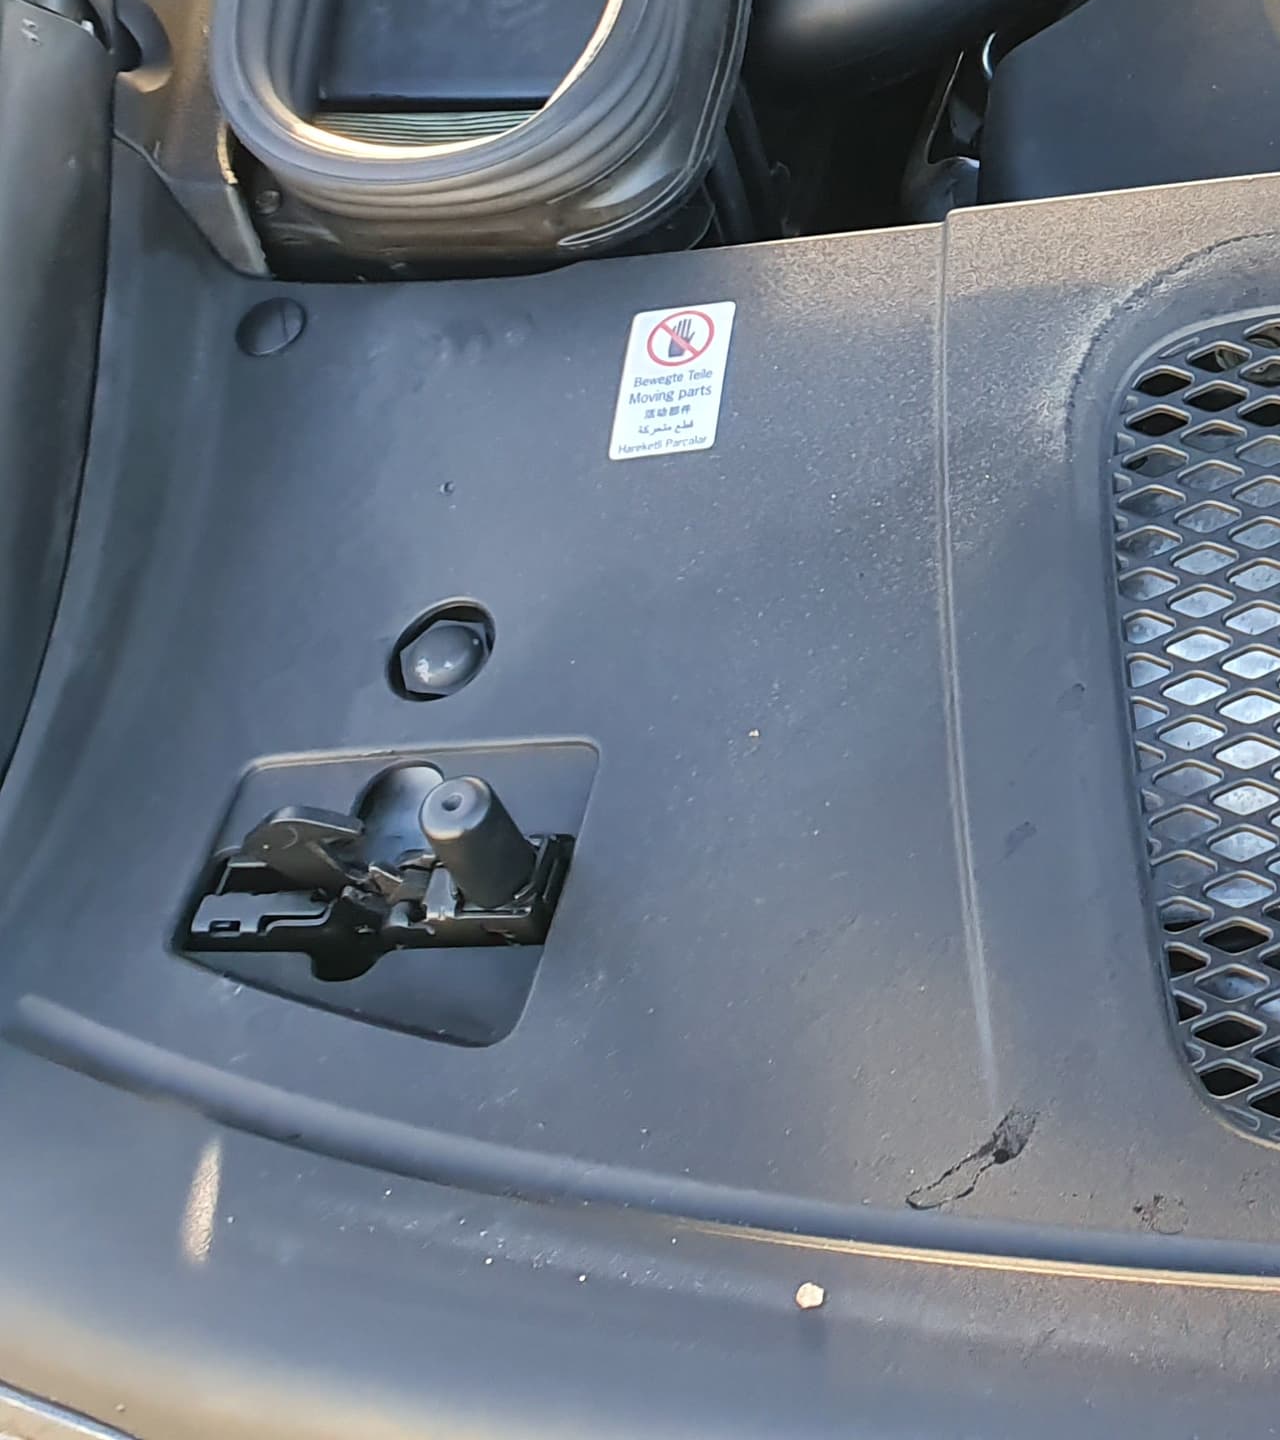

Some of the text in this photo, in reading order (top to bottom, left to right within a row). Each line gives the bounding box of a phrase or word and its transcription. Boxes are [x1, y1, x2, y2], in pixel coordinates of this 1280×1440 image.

[633, 369, 713, 388] Bewegte Teile
[629, 385, 712, 405] Moving parts
